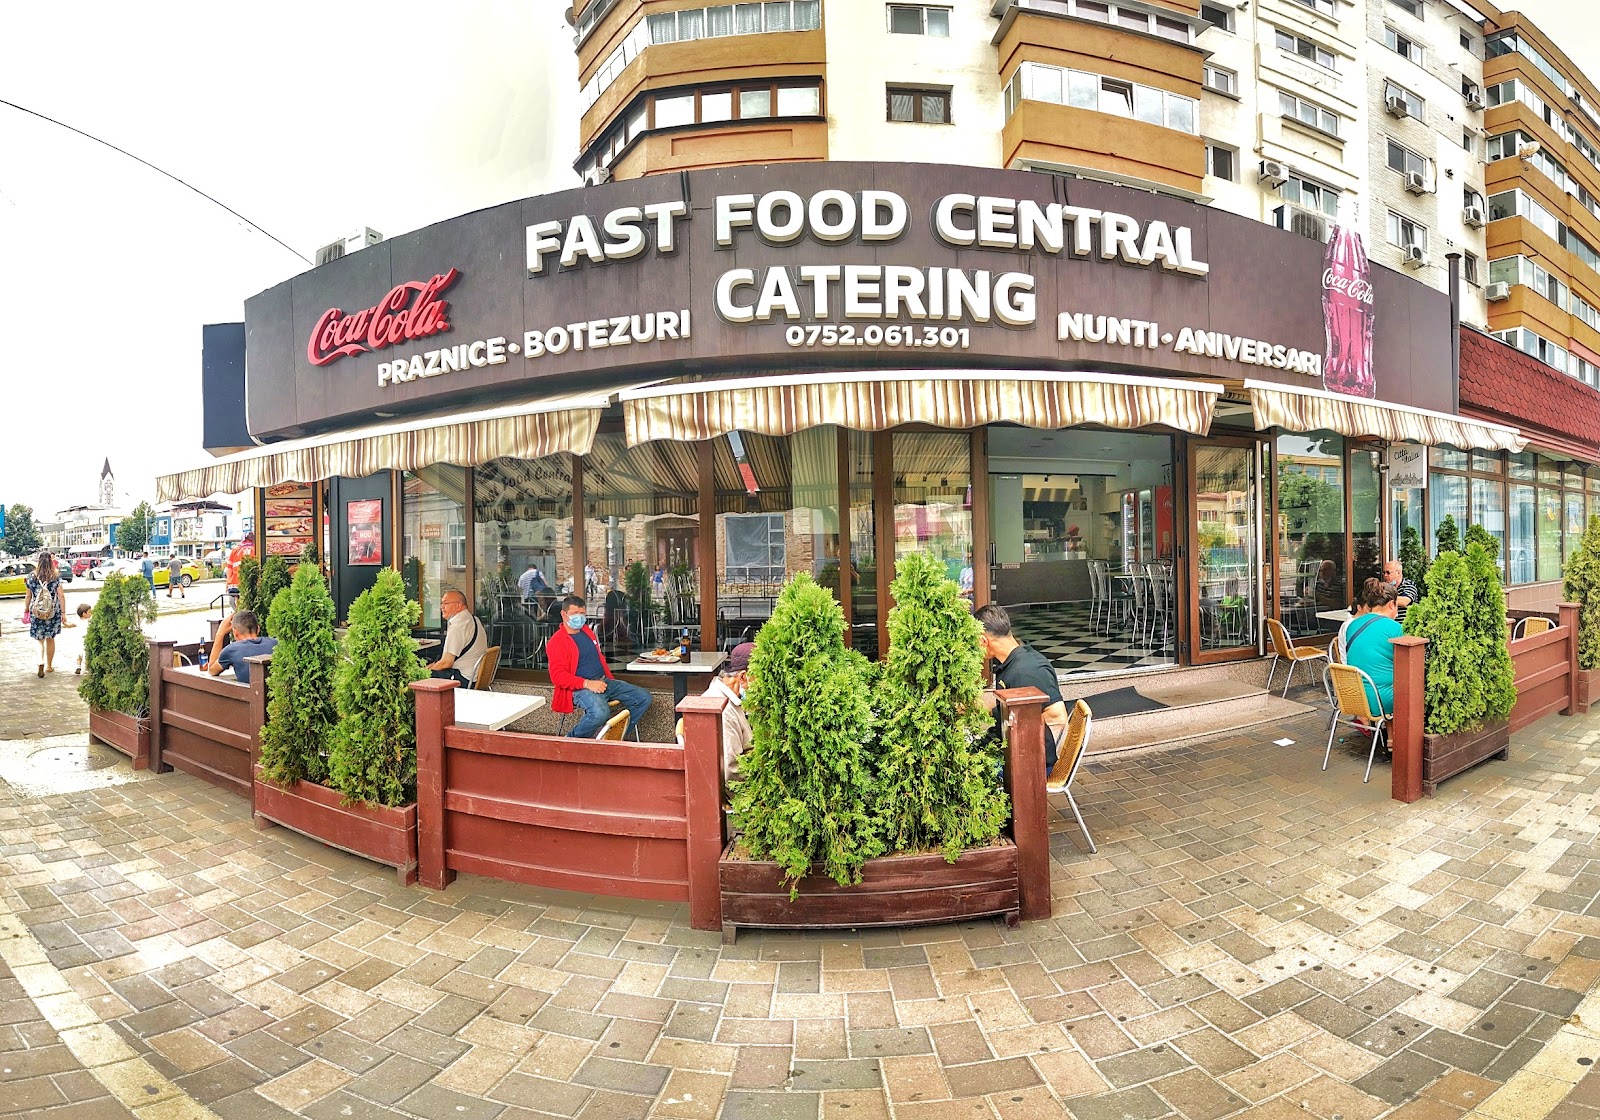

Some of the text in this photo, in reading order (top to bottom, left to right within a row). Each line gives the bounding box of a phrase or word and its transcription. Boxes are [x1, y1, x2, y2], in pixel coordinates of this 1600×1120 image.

[525, 190, 1209, 277] FAST FOOD CENTRAL
[716, 265, 1036, 325] CATERING
[377, 308, 691, 388] PRAZNICE BOTEZURI
[786, 325, 971, 349] 0752.061.301
[1058, 312, 1322, 377] NUNTI ANIVERSARI
